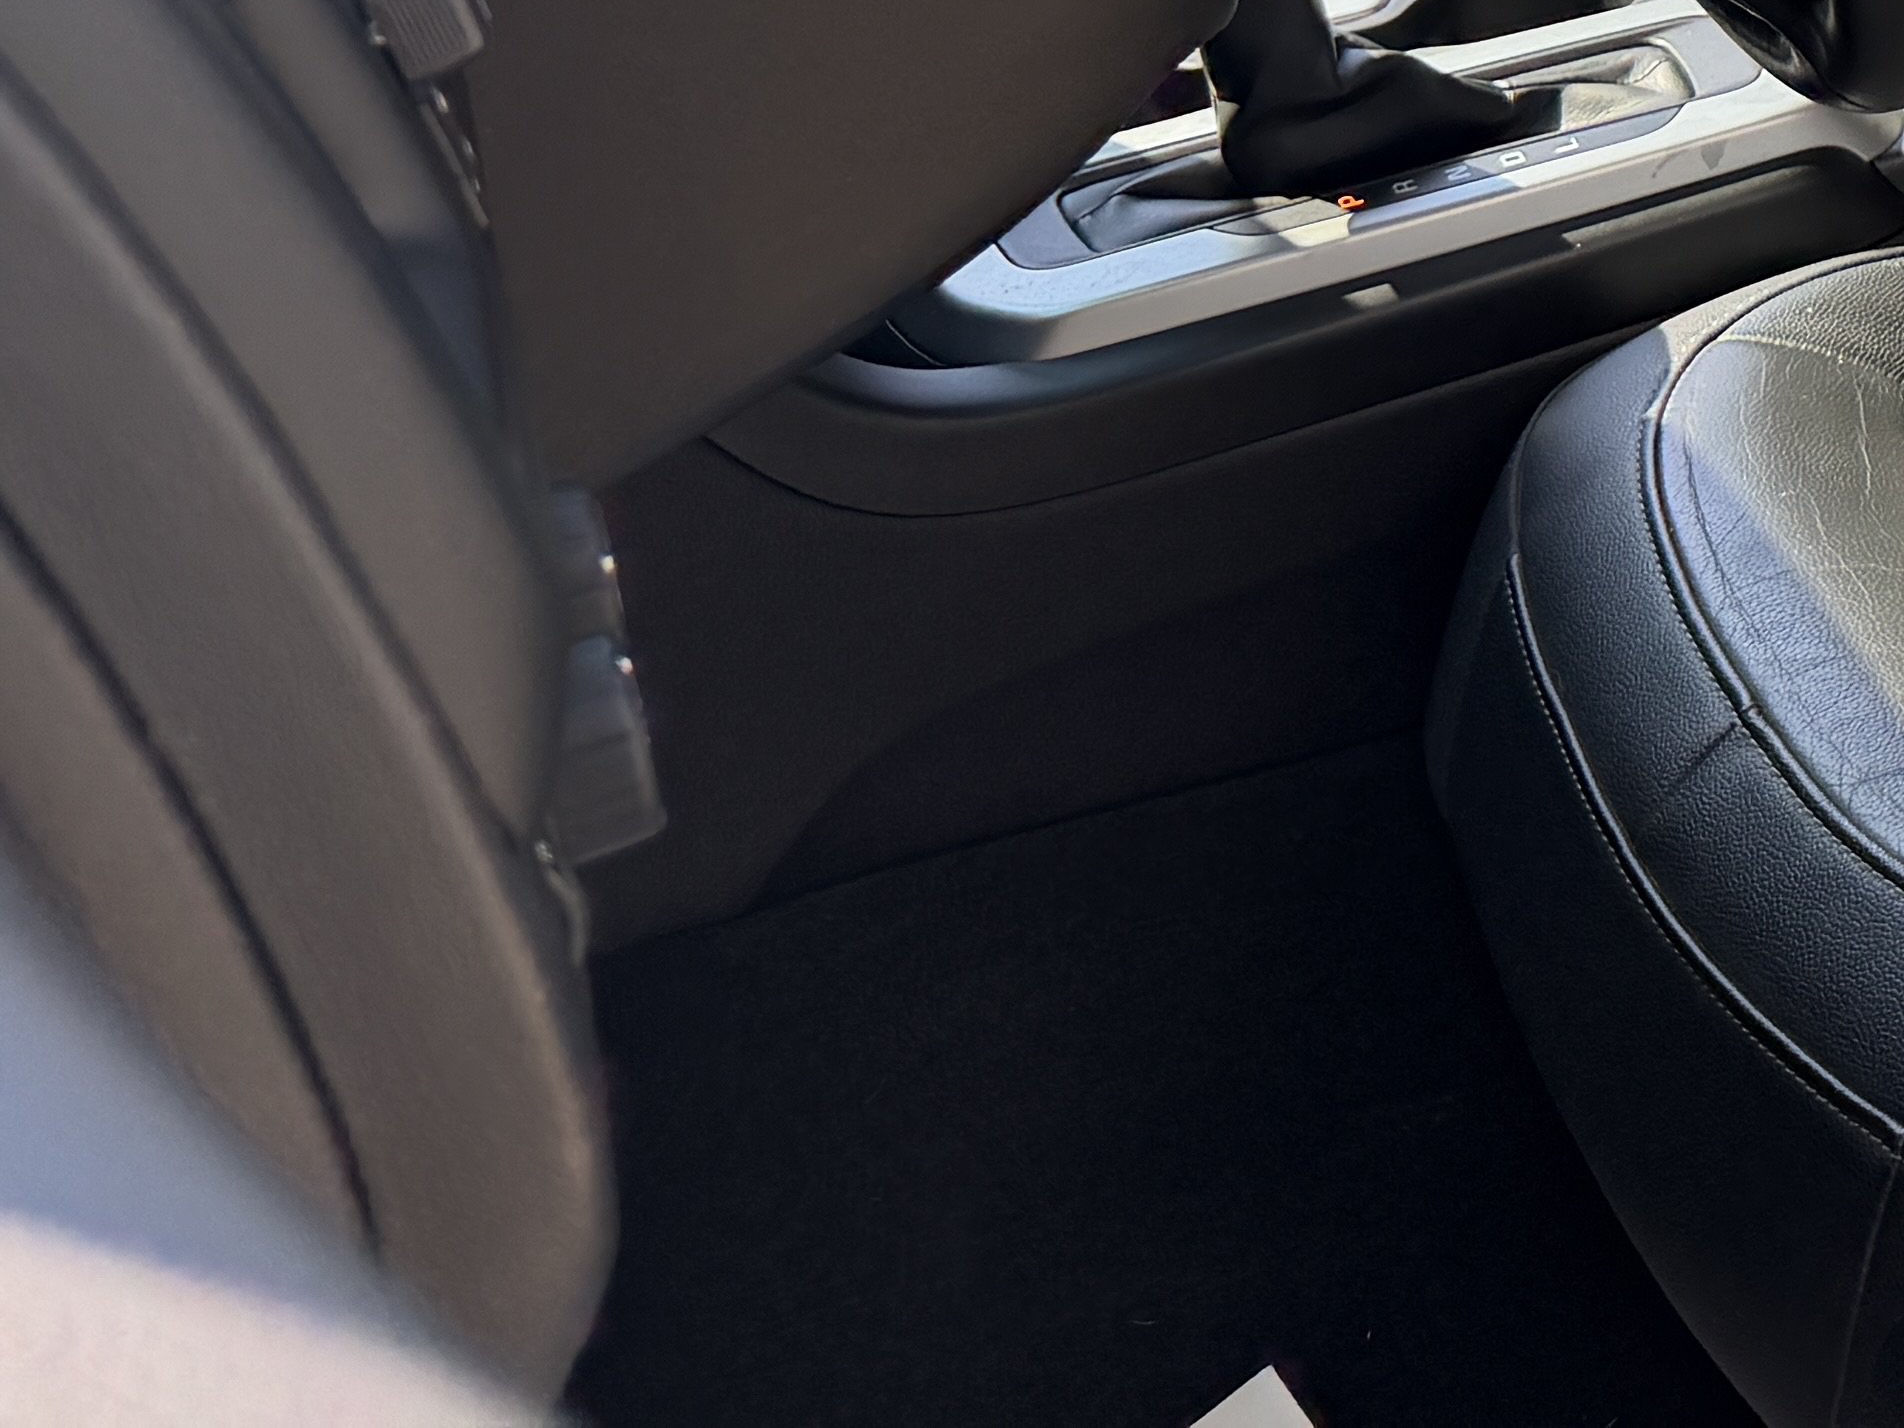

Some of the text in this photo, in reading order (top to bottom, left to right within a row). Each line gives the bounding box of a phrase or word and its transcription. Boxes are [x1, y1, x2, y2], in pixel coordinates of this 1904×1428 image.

[1337, 136, 1580, 210] P R N D L
